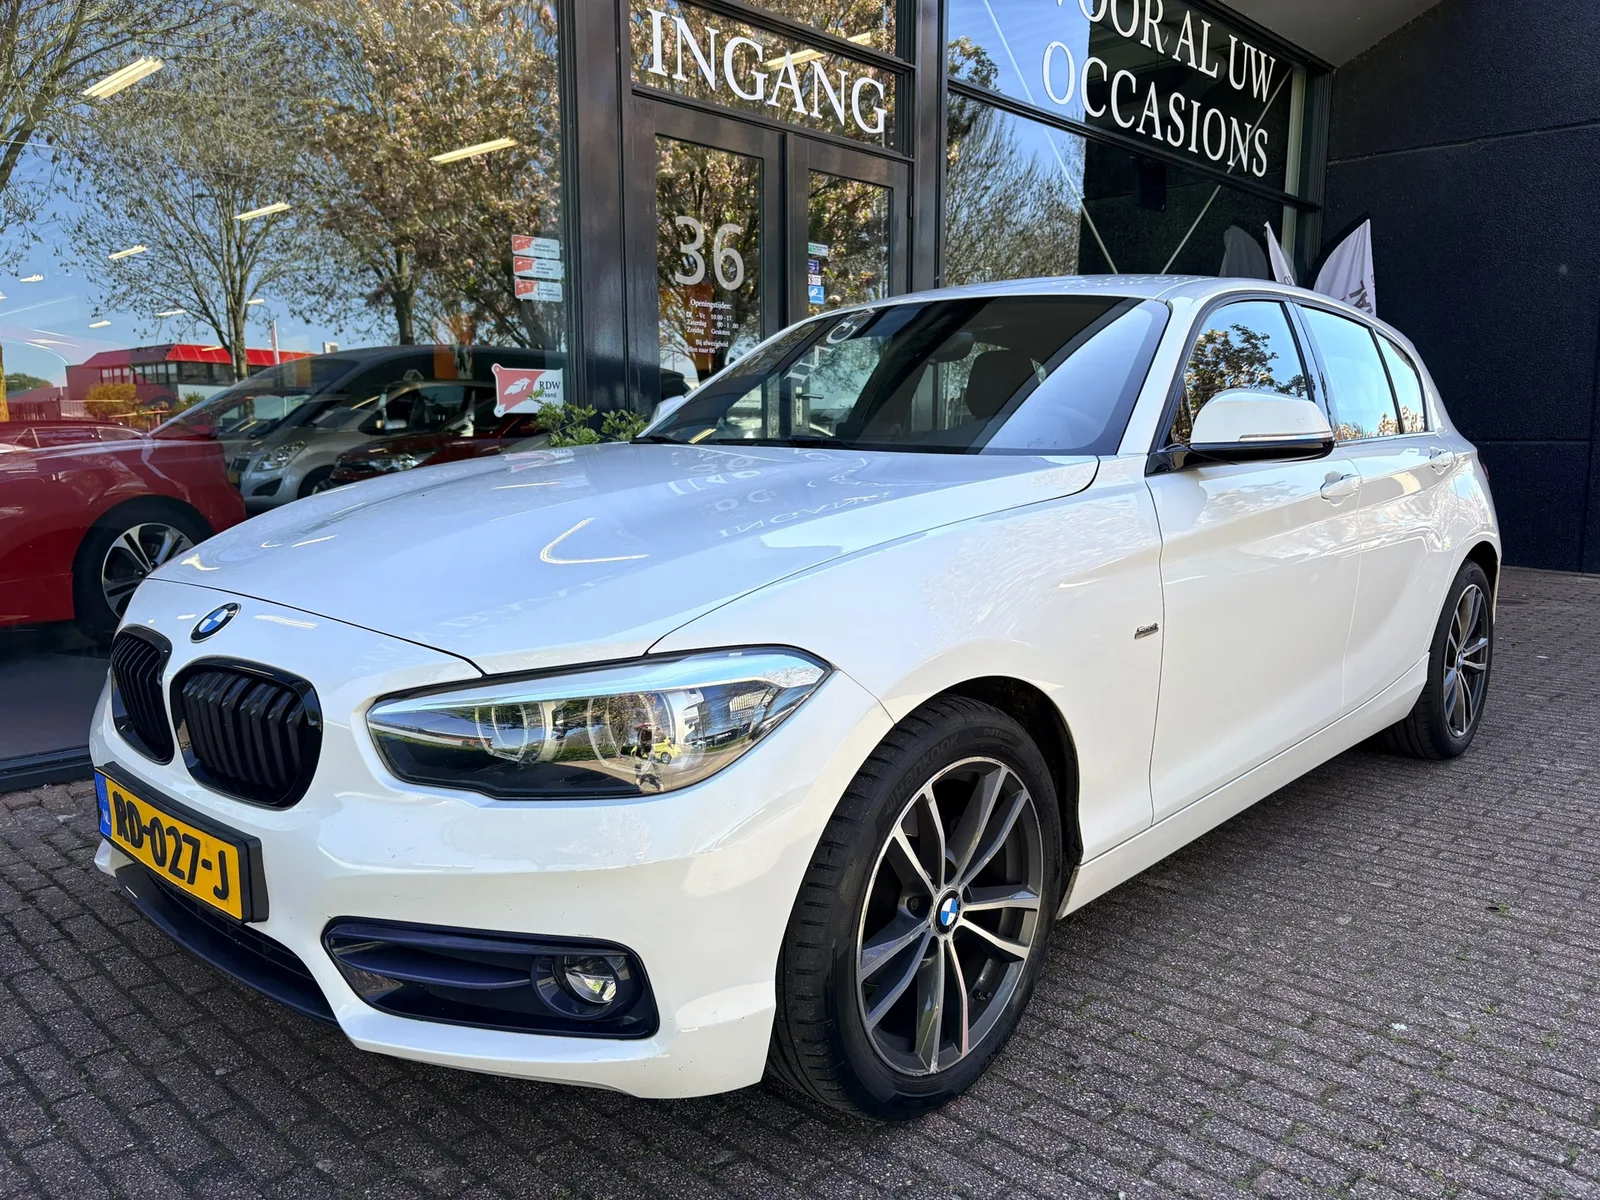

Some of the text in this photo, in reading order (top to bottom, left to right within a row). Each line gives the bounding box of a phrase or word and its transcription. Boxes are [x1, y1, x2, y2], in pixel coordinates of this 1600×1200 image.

[646, 7, 888, 134] INGANG
[1172, 10, 1219, 79] AL
[1228, 33, 1276, 103] UW
[1041, 40, 1269, 178] OCCASIONS
[675, 215, 745, 291] 36
[539, 380, 562, 390] RDW
[112, 790, 231, 901] RD-027-J
